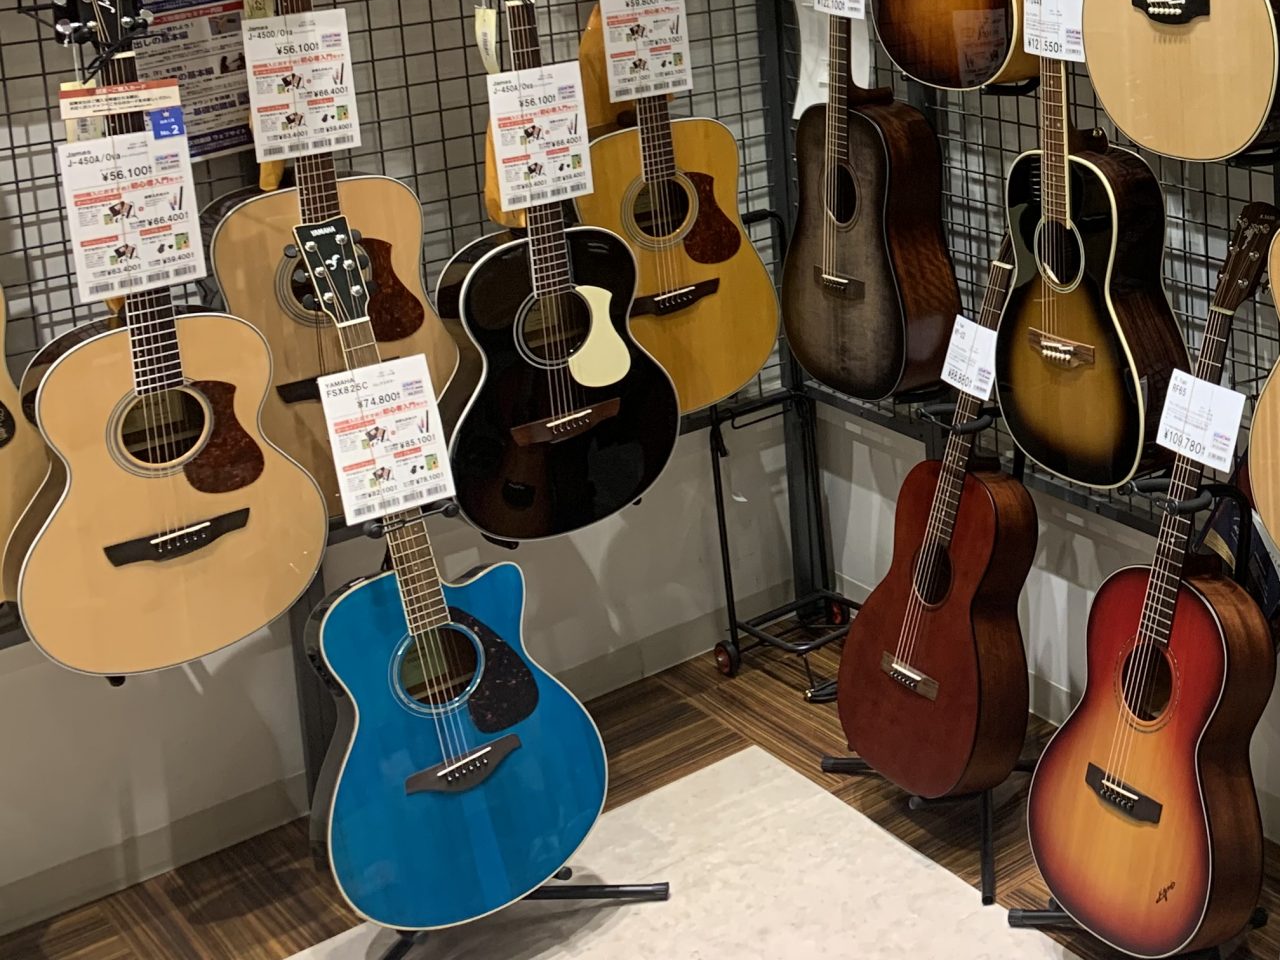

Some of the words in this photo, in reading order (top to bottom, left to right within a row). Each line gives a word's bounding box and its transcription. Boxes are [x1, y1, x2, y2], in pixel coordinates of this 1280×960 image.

[310, 226, 336, 237] YAMAHA
[325, 378, 355, 388] YAMAHA
[326, 381, 369, 398] FSX825C
